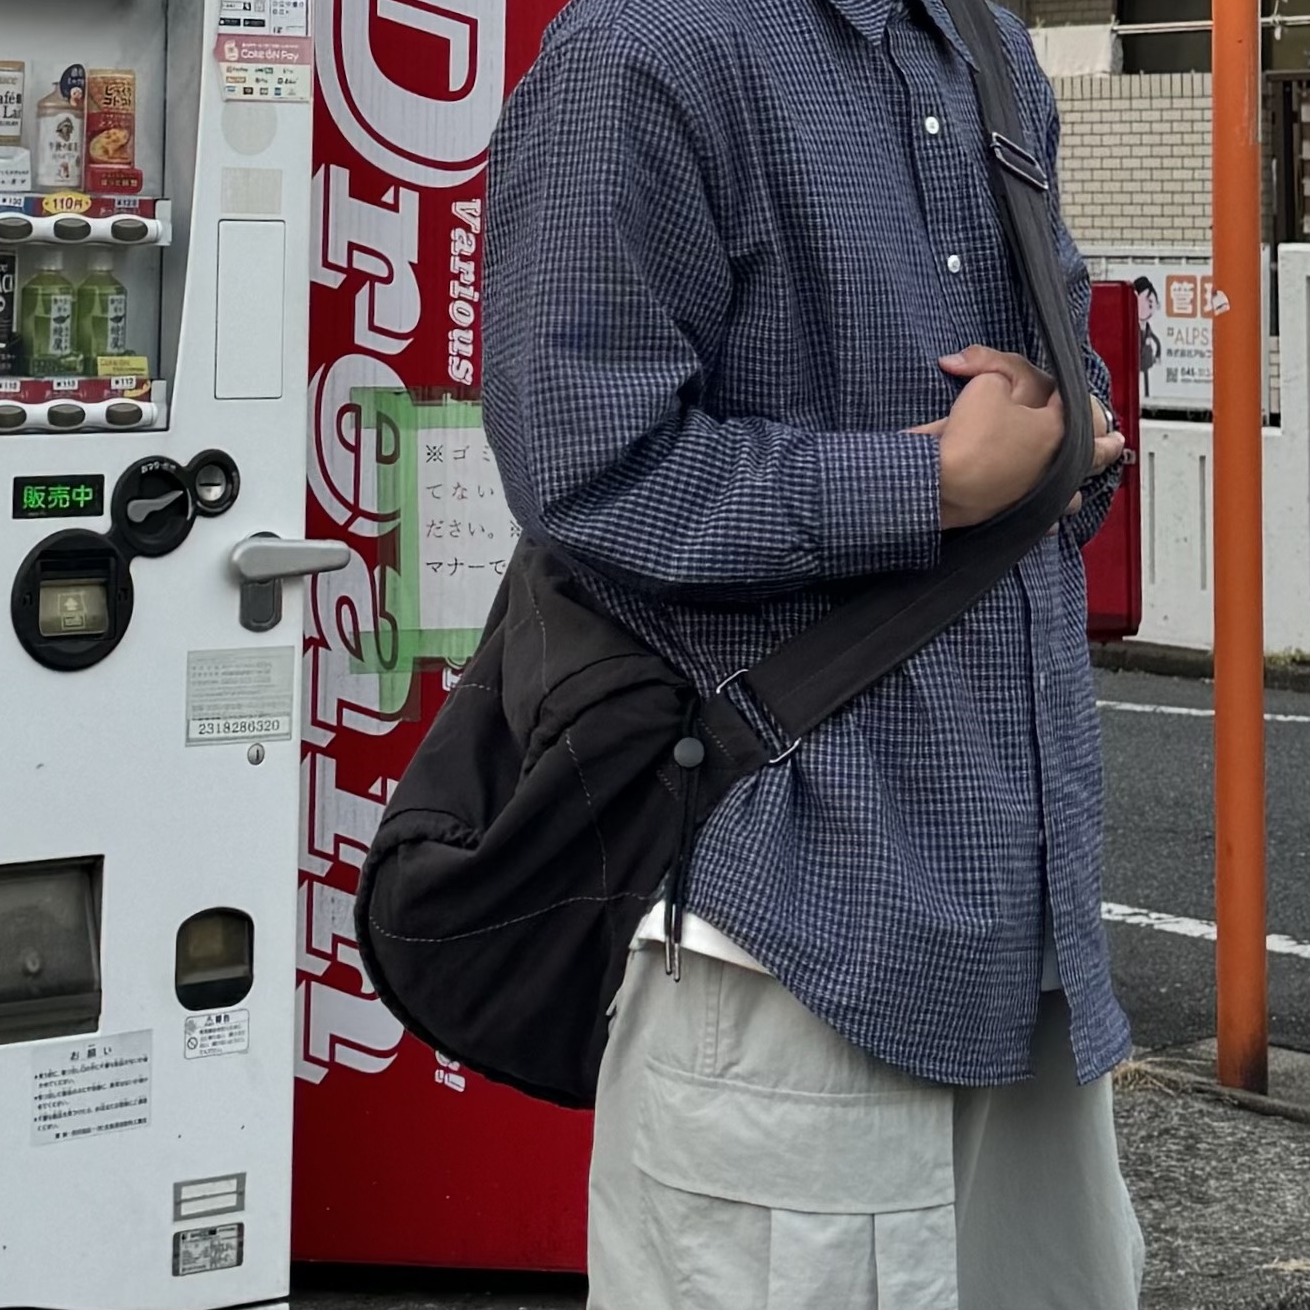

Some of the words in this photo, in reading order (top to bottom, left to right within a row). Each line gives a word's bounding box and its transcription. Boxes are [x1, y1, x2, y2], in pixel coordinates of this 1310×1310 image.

[241, 49, 265, 60] Coke
[281, 49, 299, 62] Pay
[52, 197, 83, 210] 110円
[447, 197, 483, 385] Various
[1174, 326, 1210, 346] ALPS
[22, 484, 94, 510] 販売中
[425, 481, 495, 502] てない
[425, 556, 508, 576] マナーで
[69, 1046, 113, 1062] お願い
